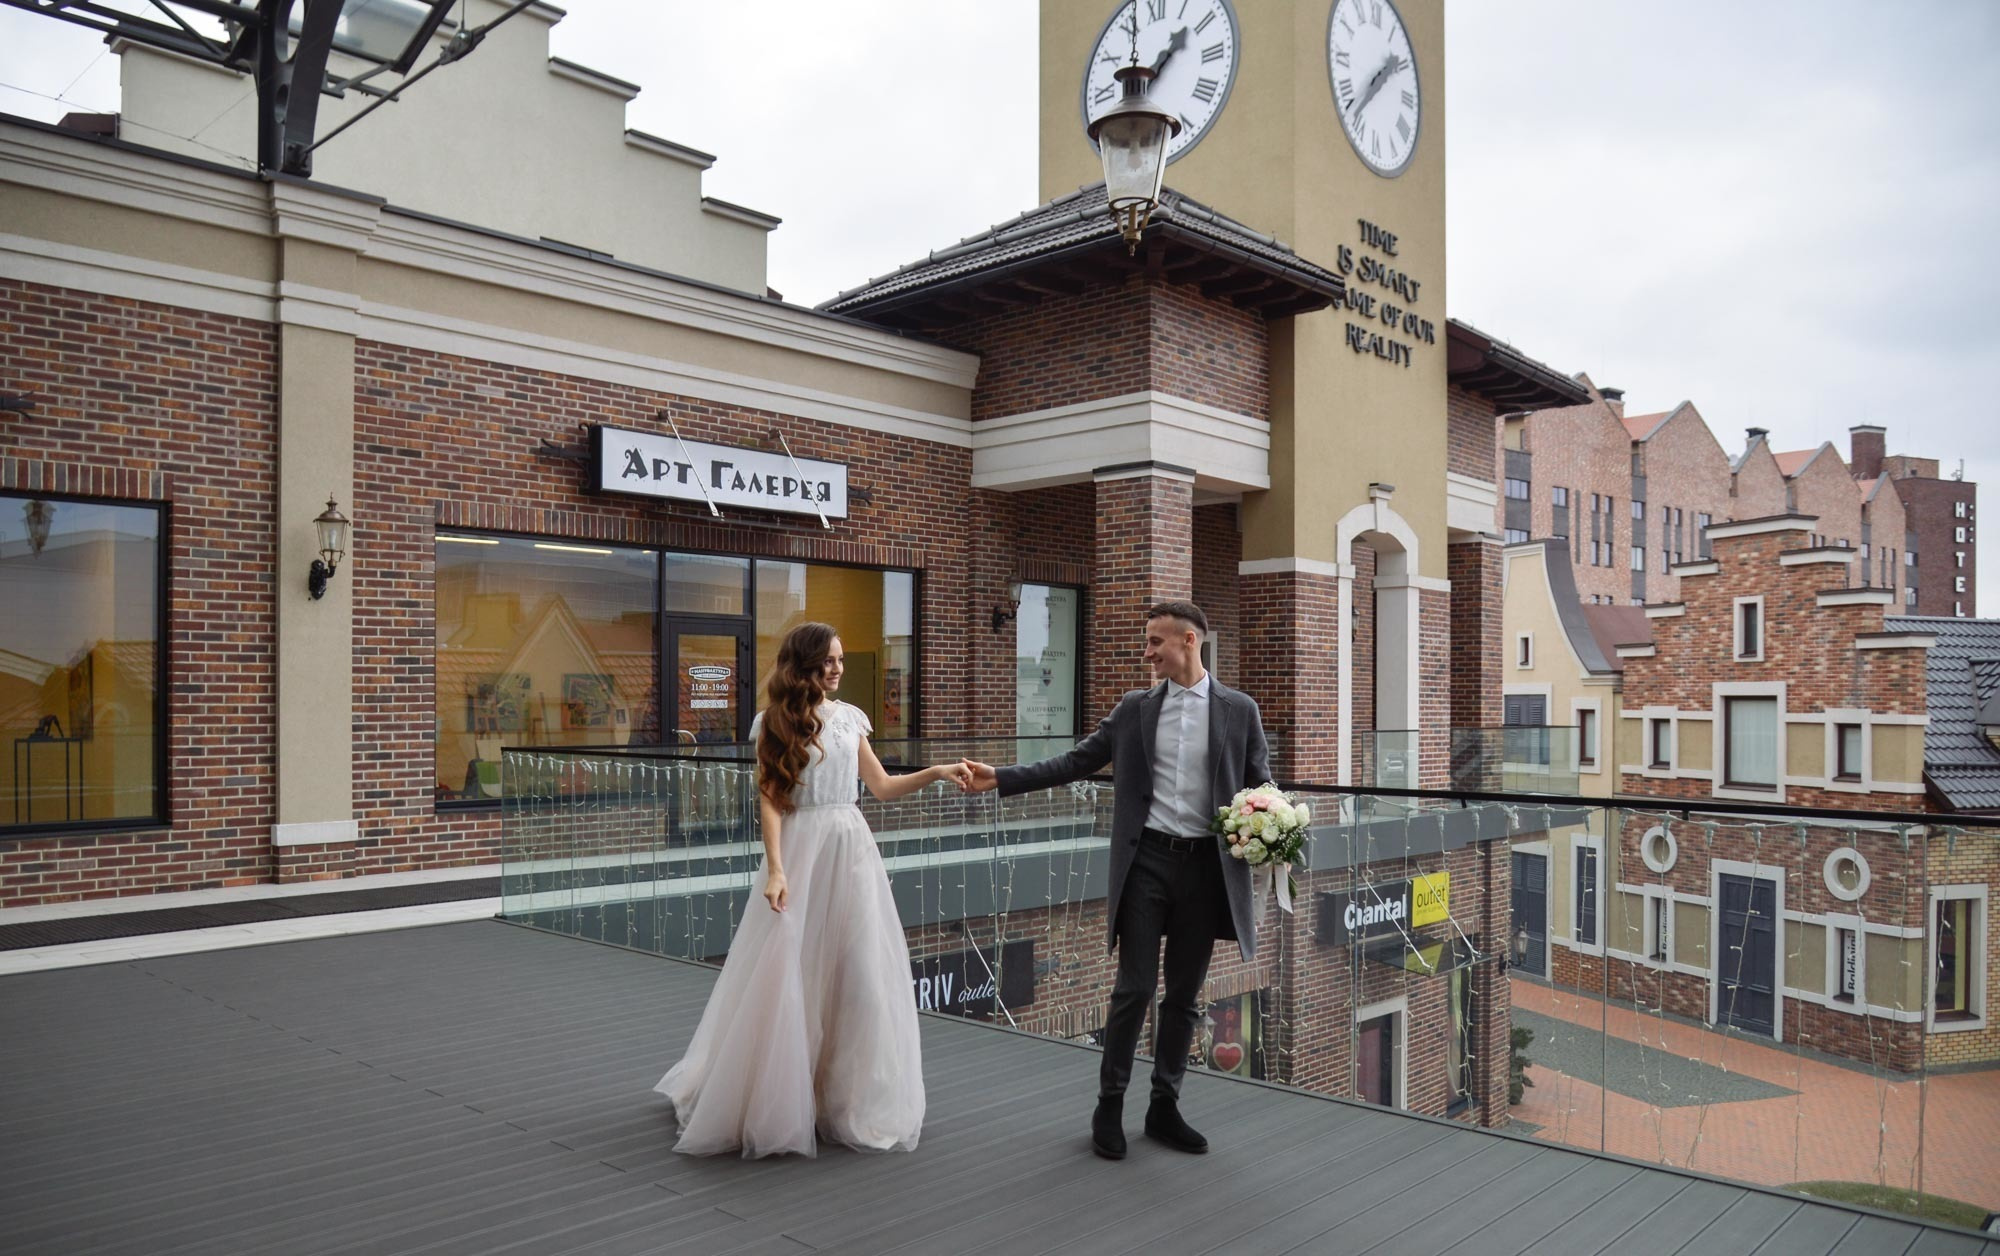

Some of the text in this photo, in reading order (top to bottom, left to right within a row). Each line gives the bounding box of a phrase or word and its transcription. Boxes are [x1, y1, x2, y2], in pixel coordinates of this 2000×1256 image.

[1201, 42, 1223, 64] III
[1358, 218, 1398, 256] TIME
[1337, 244, 1420, 303] IS SMART
[1381, 302, 1402, 328] OF
[1403, 312, 1435, 345] OUR
[1345, 322, 1413, 368] REALITY
[1955, 501, 1966, 618] HOTEL
[713, 683, 729, 691] 19:00
[1416, 885, 1445, 908] outlet
[958, 976, 996, 1003] outle
